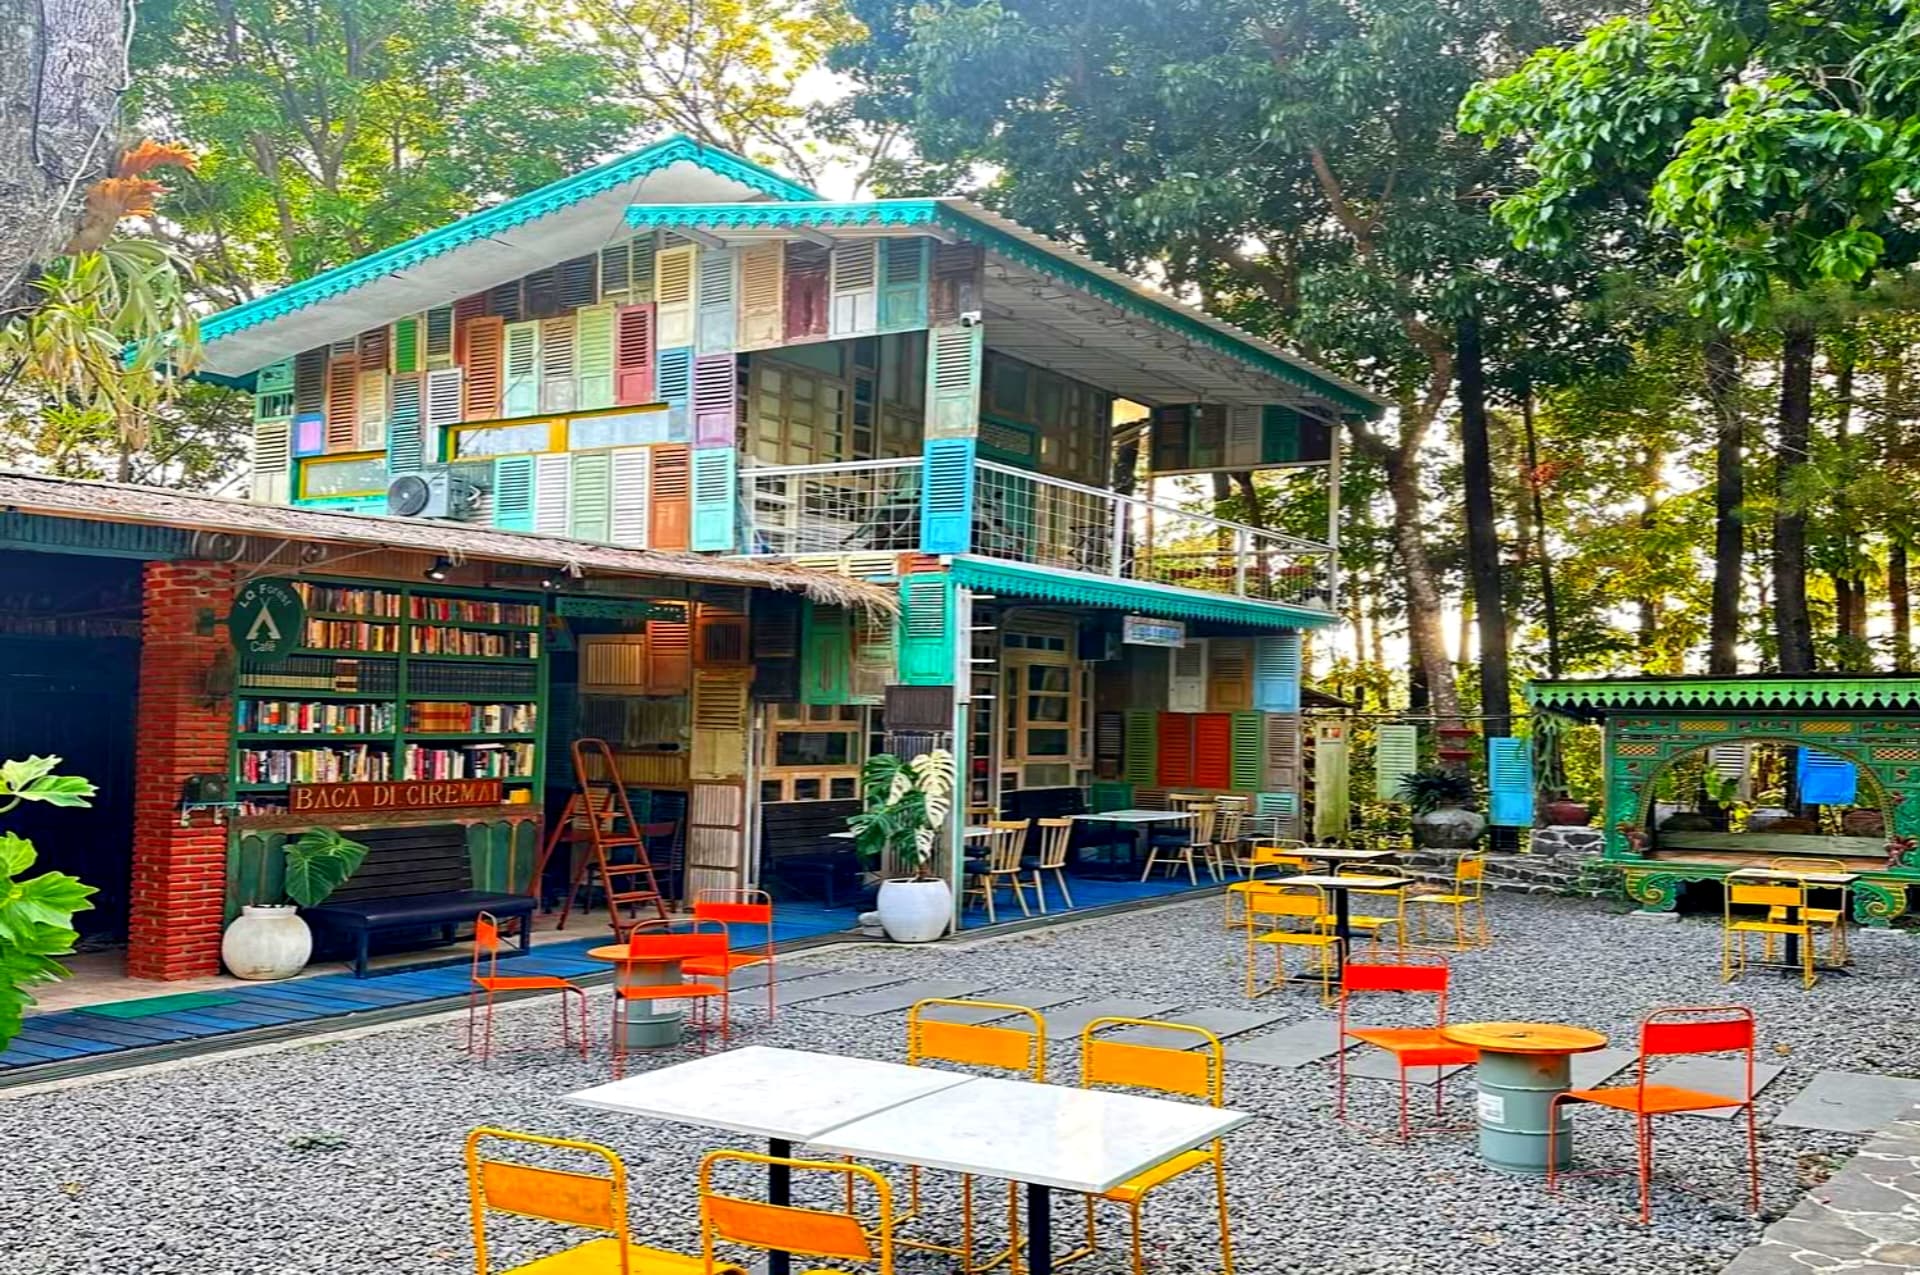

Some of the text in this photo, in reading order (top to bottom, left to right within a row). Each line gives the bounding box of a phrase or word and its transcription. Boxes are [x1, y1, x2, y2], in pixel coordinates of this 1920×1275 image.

[259, 584, 292, 607] Forest
[296, 782, 498, 809] BACA DI CIREMAI
